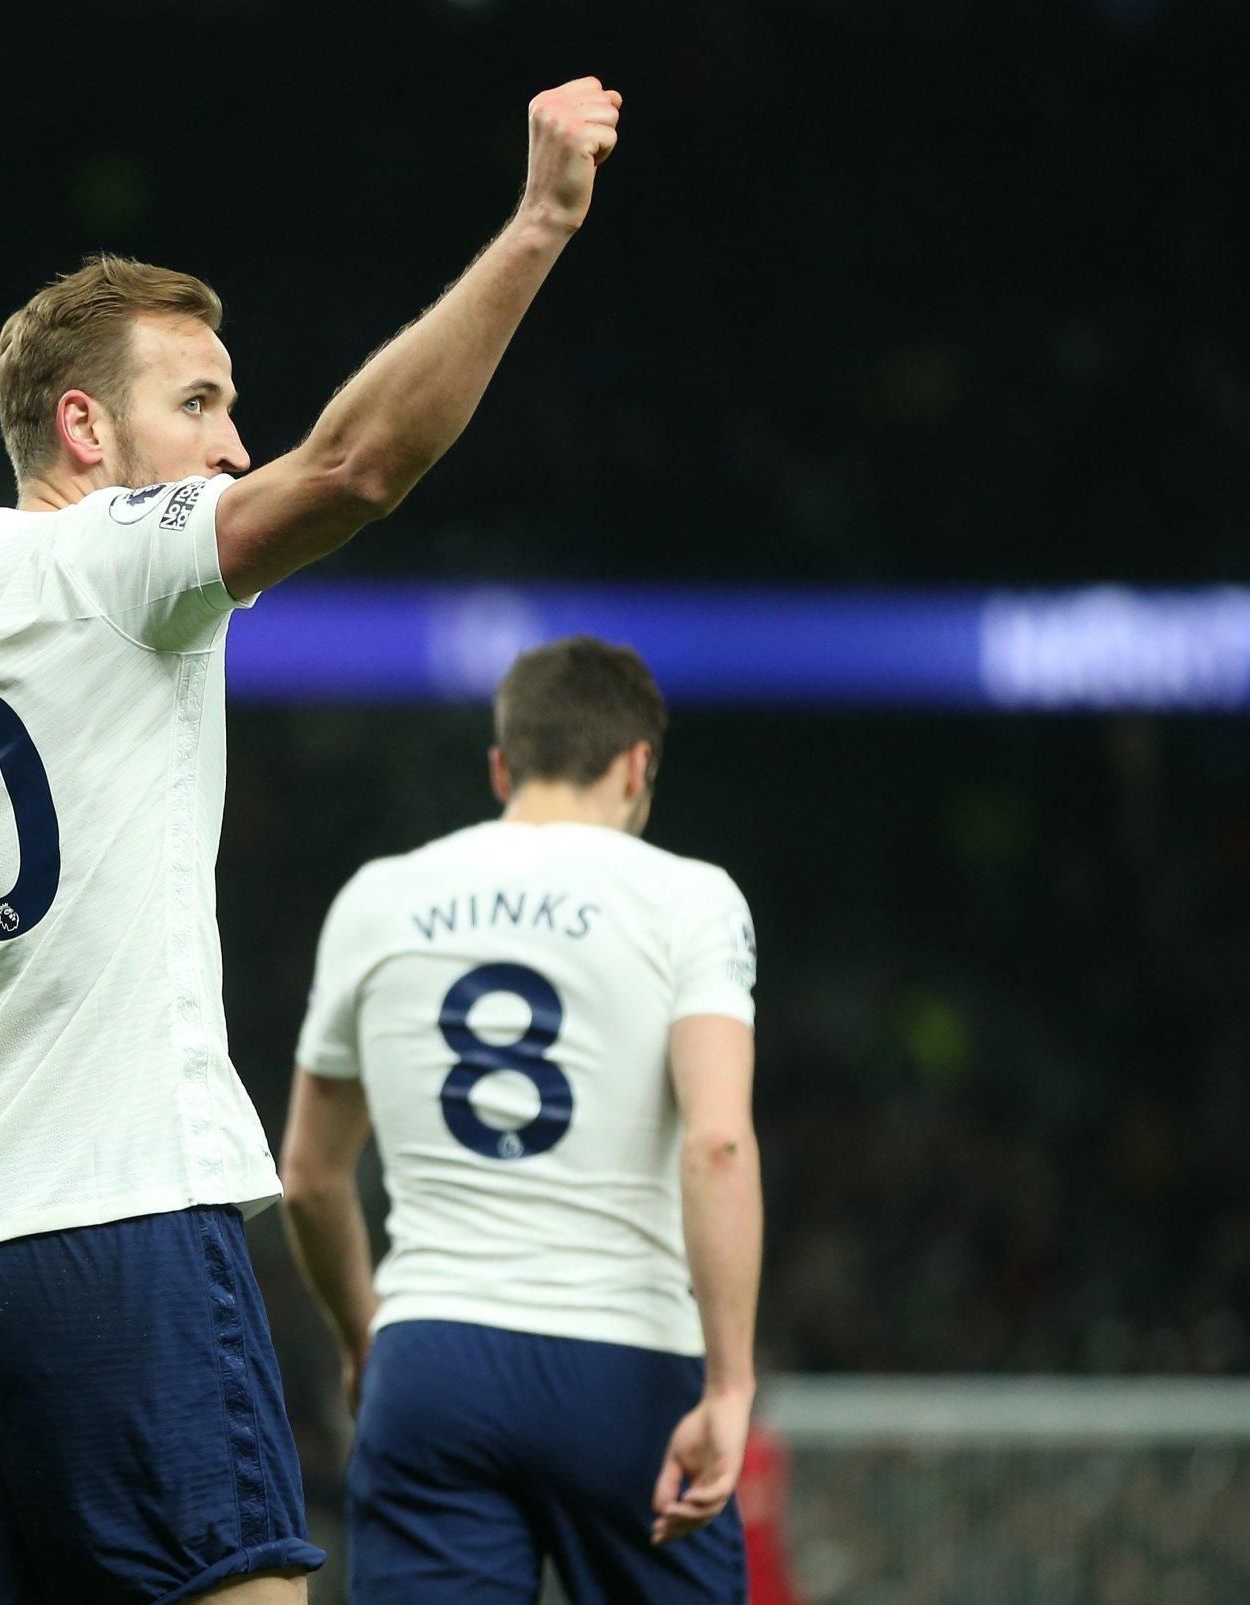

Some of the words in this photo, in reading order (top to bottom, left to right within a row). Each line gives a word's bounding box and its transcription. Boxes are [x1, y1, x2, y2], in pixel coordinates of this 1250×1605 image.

[160, 503, 181, 529] No
[411, 890, 603, 942] WINKS
[437, 961, 575, 1160] 8
